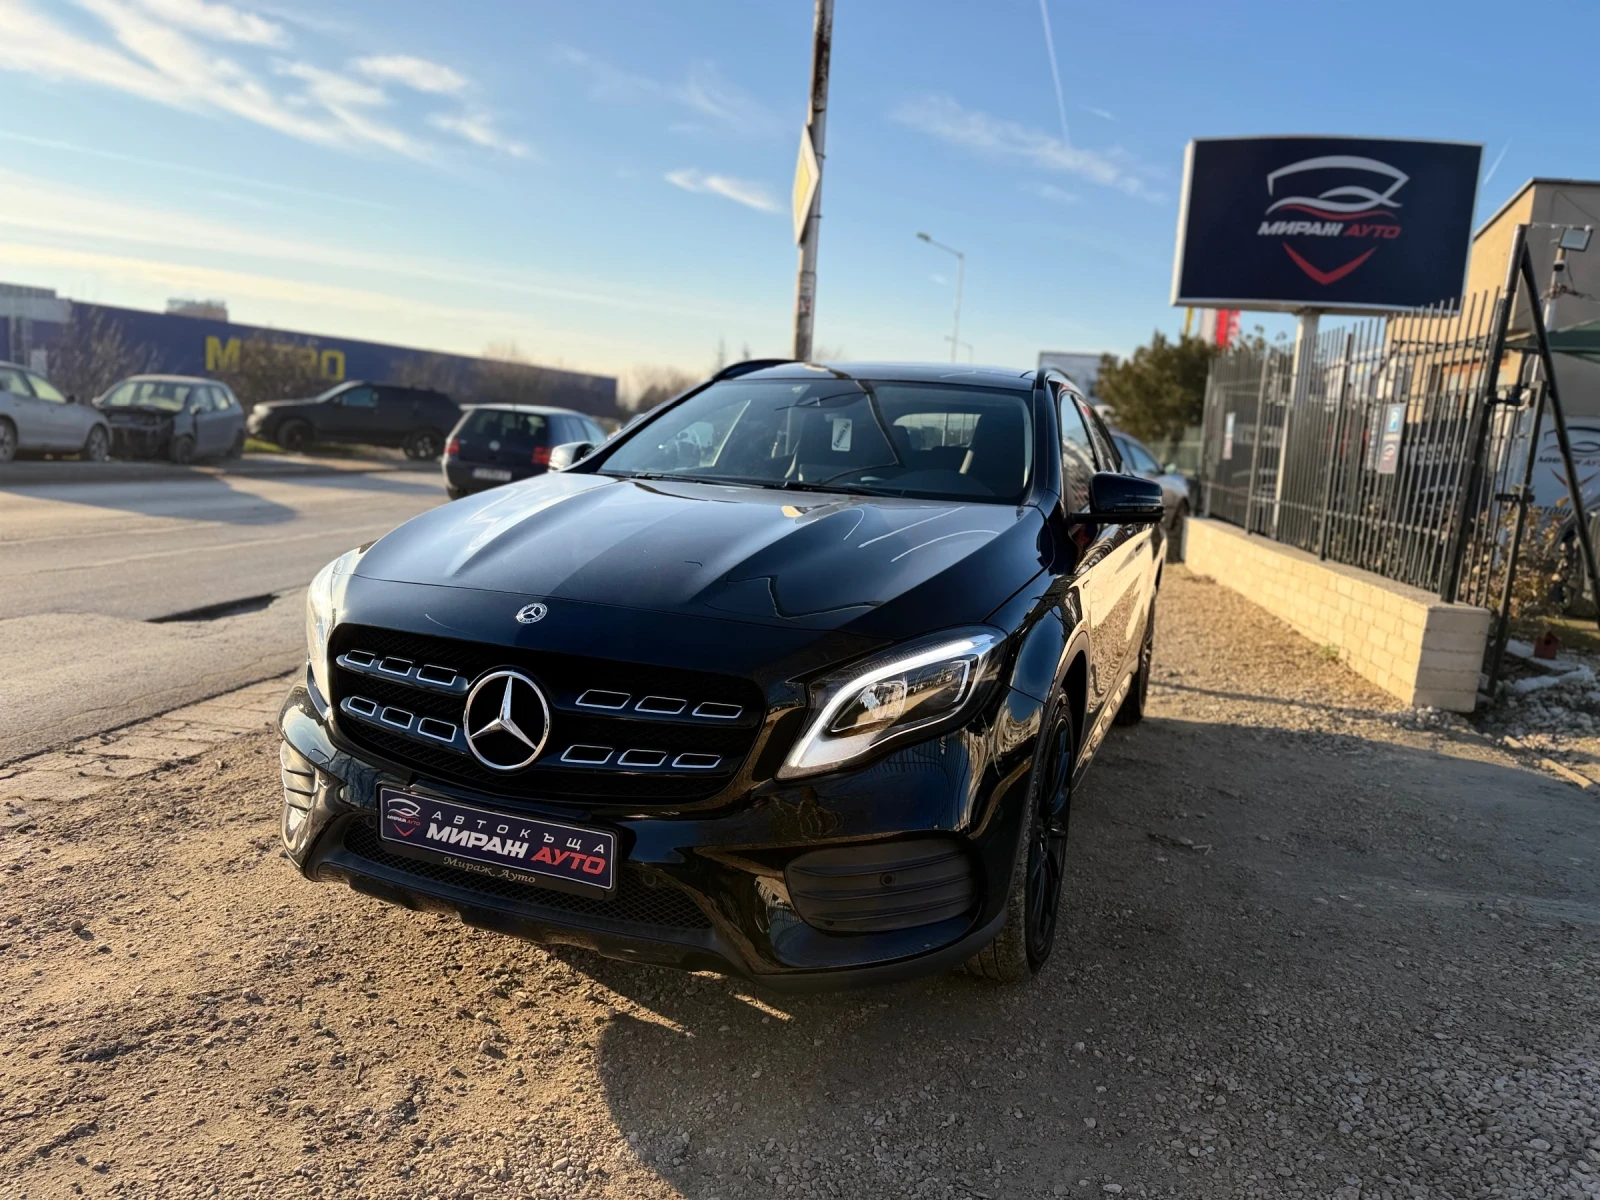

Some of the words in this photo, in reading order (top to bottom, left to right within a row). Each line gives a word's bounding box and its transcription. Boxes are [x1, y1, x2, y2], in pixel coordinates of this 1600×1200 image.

[1257, 221, 1344, 237] МИРАЖ
[1344, 223, 1402, 239] АУТО
[425, 823, 529, 859] МИРАЖ
[530, 846, 606, 875] АУТО
[431, 810, 605, 855] АВТОКЪЩА
